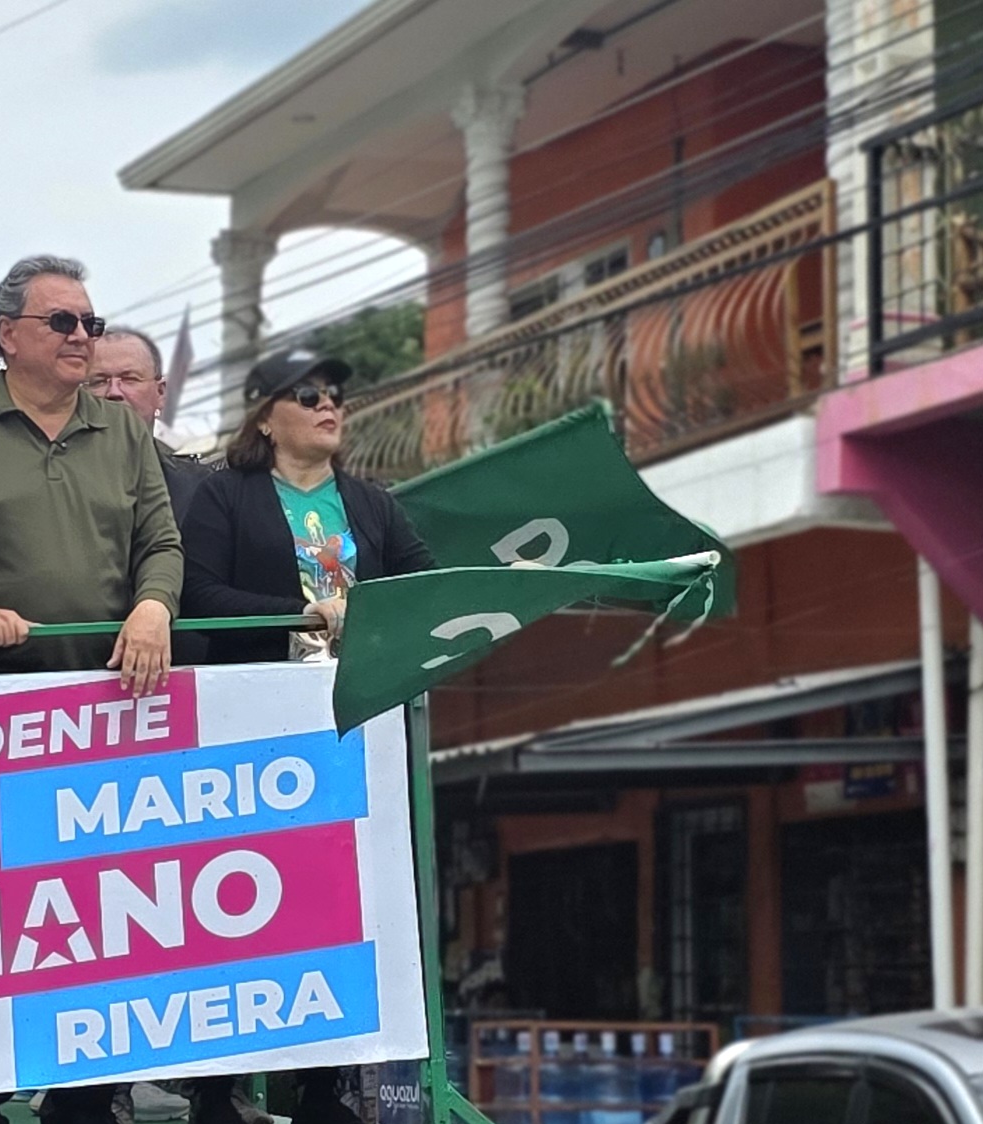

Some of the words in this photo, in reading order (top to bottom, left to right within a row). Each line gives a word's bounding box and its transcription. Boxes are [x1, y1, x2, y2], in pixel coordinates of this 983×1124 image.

[55, 755, 316, 842] MARIO
[55, 971, 344, 1065] RIVERA
[379, 1080, 421, 1108] aguazul
